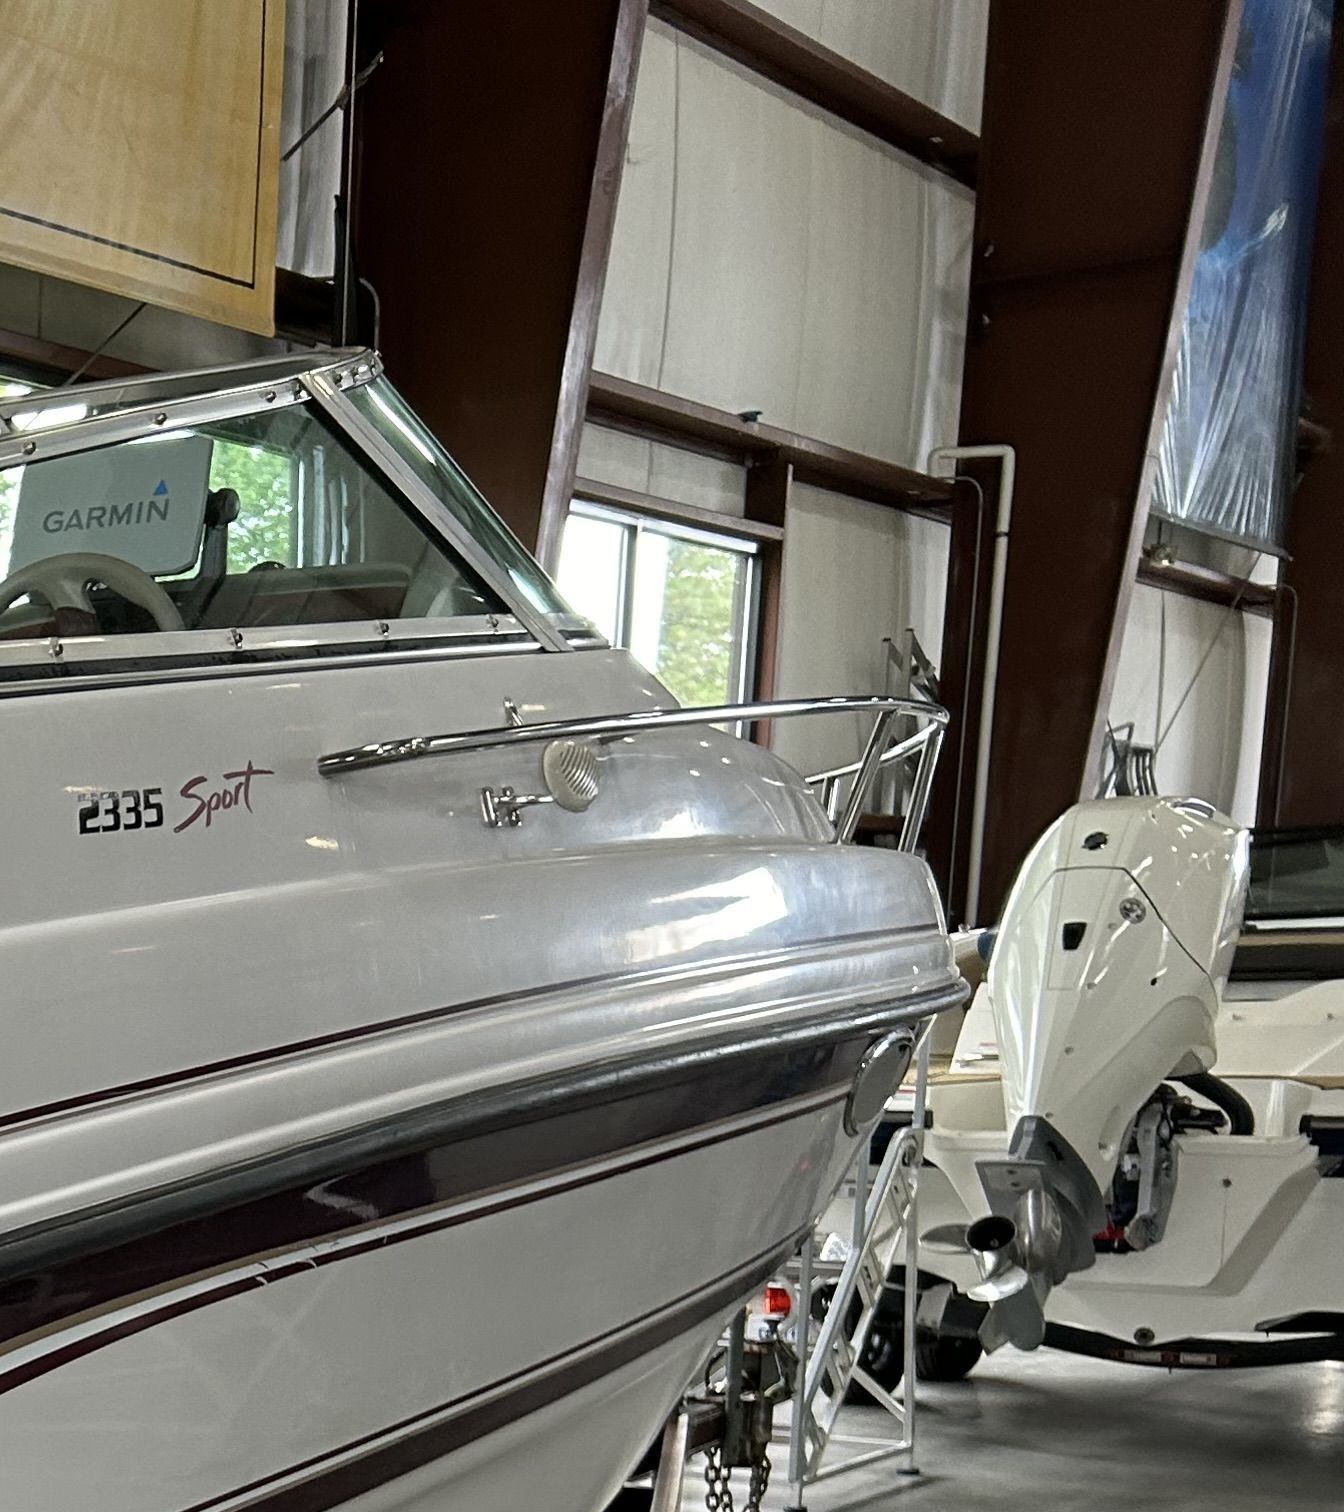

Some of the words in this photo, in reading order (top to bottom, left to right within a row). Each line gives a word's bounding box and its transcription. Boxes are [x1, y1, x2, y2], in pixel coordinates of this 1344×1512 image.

[43, 498, 170, 533] GARMIN
[77, 788, 163, 835] 2335
[173, 760, 275, 833] Sport
